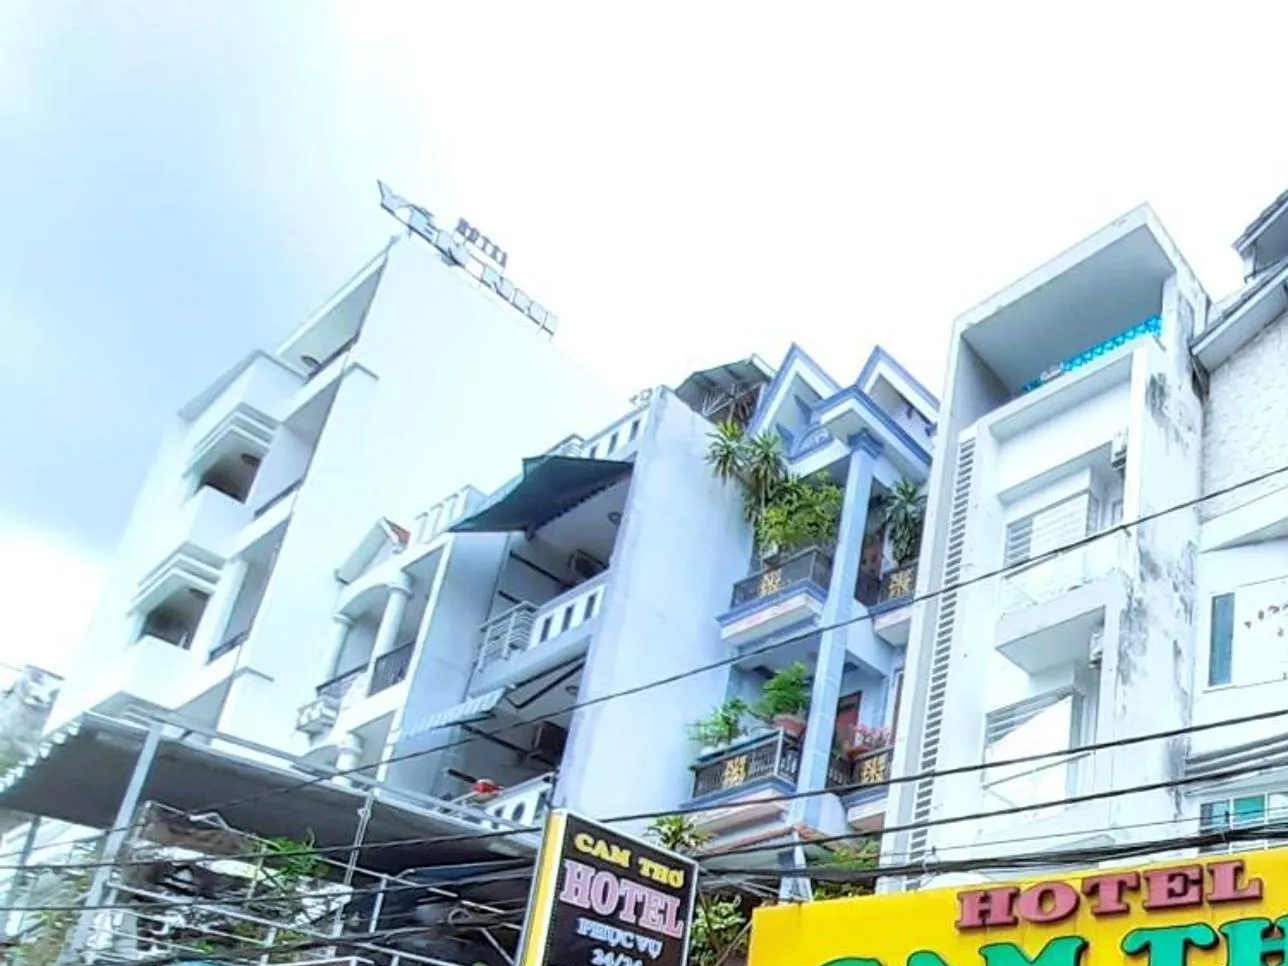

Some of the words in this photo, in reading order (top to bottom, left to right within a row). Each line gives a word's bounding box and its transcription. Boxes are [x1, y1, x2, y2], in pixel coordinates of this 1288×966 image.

[574, 833, 632, 867] CAM
[560, 859, 684, 938] HOTEL
[956, 860, 1263, 932] HOTEL
